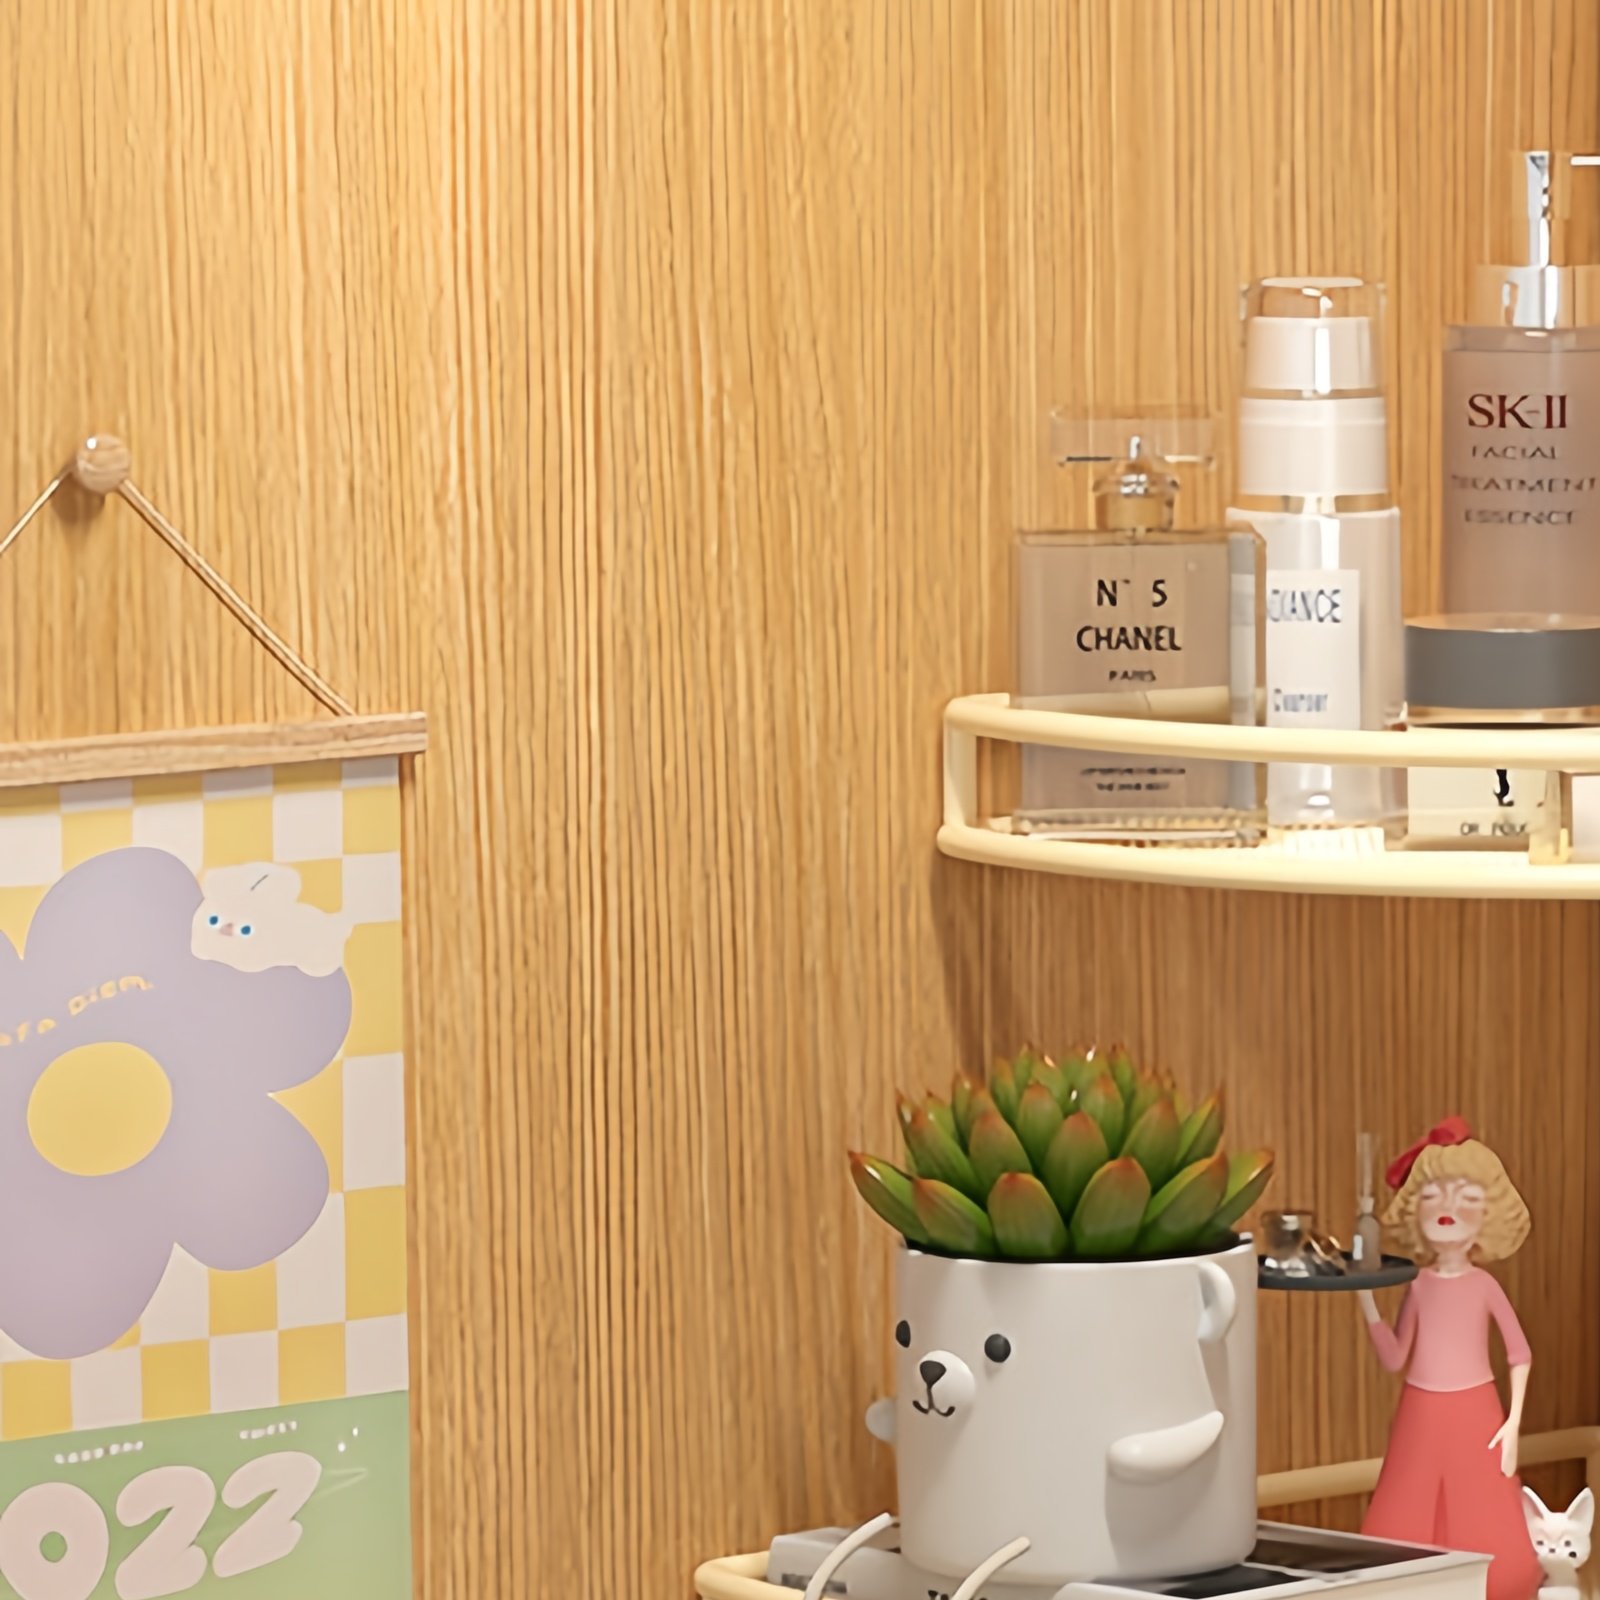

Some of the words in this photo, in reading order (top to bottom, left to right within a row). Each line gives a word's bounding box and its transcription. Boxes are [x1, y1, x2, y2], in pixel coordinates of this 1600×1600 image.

[1467, 392, 1567, 430] SK-II
[1151, 578, 1168, 608] 5
[1076, 625, 1182, 652] CHANEL
